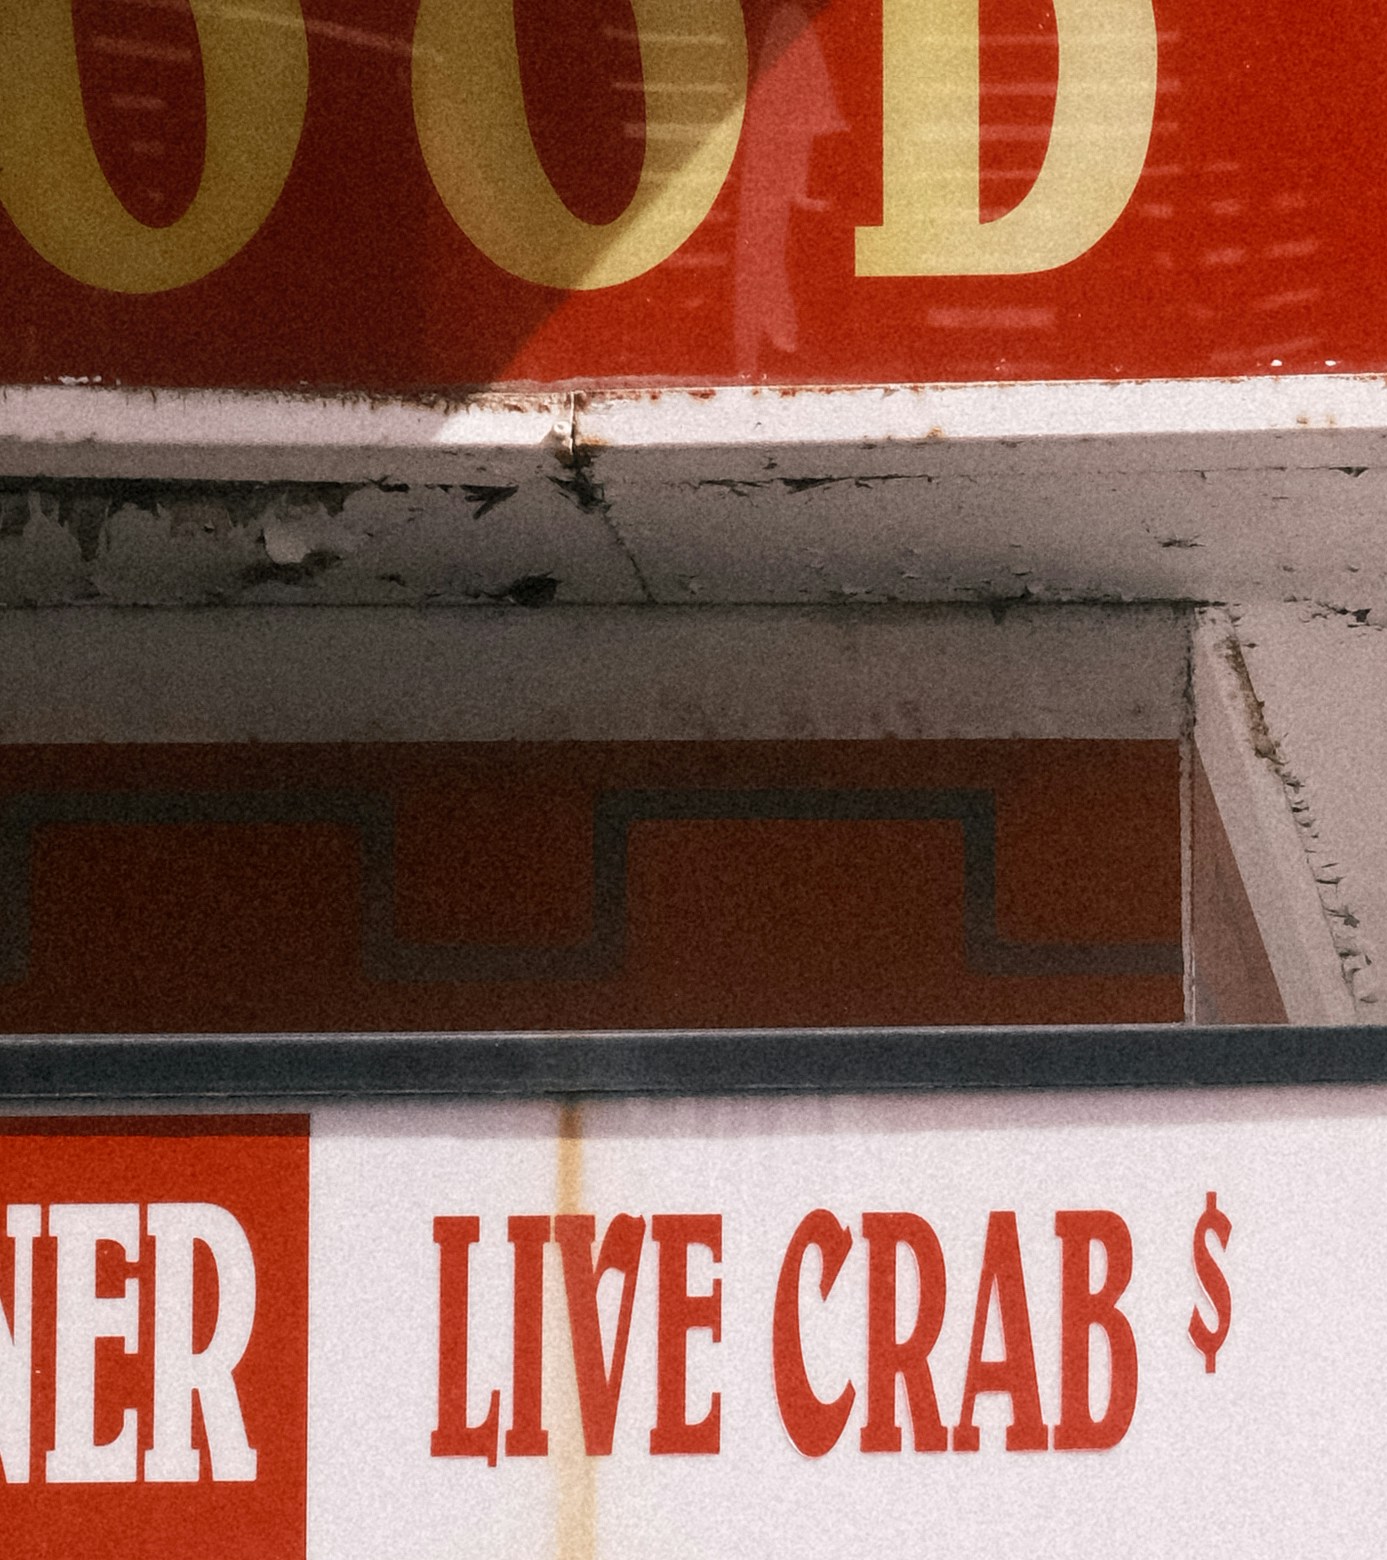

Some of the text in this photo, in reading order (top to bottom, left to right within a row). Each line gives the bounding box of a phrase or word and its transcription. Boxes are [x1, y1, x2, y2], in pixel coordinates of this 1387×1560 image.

[430, 1212, 722, 1468] LIVE
[772, 1208, 1139, 1458] CRAB
[1188, 1191, 1232, 1373] $
